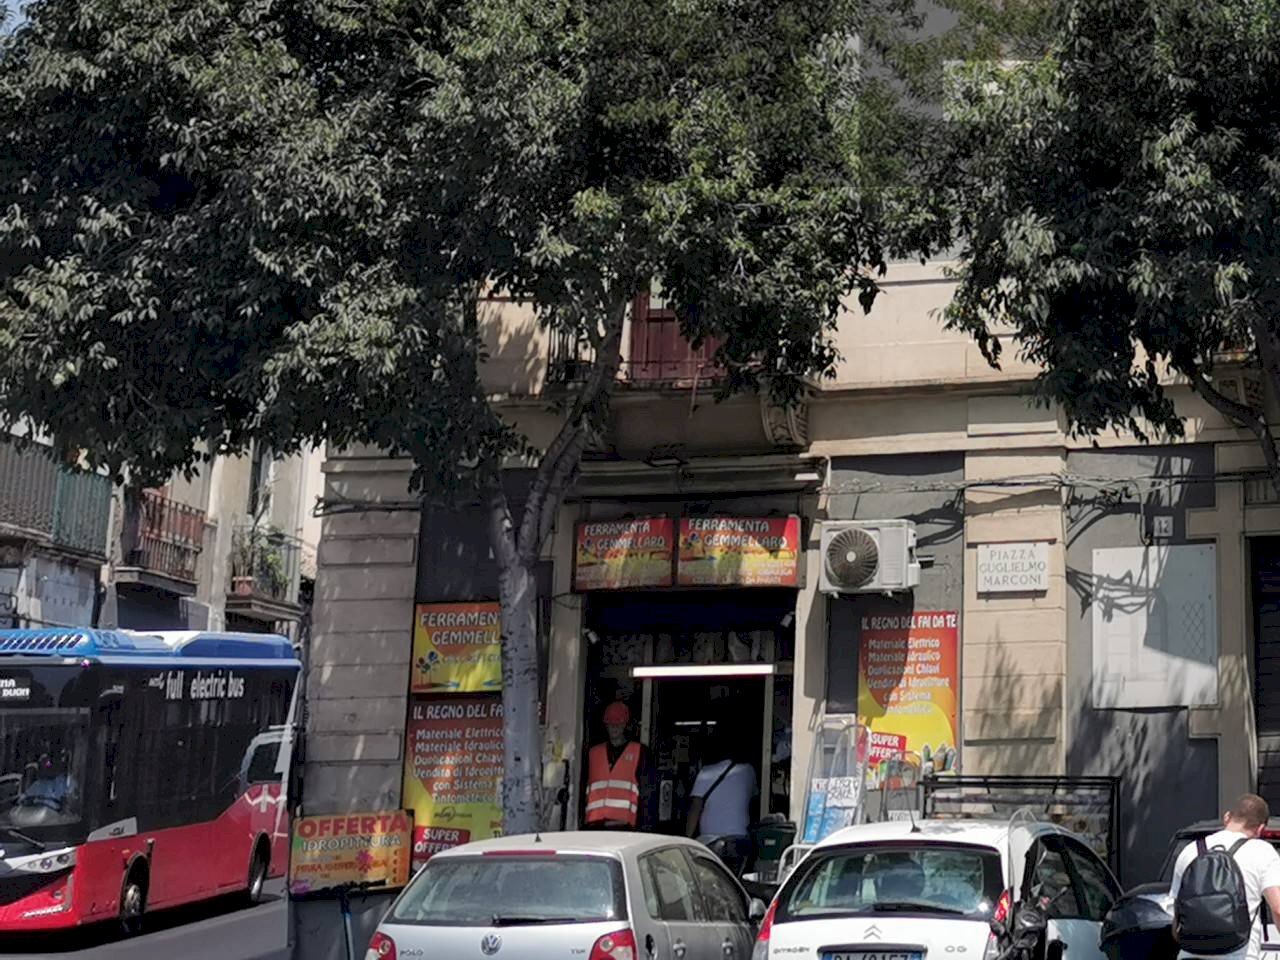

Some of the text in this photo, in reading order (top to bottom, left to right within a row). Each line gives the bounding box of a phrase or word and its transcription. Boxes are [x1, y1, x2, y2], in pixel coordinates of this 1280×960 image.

[584, 522, 650, 537] FERRAMENTA
[688, 518, 770, 532] FERRAMENTA
[1158, 520, 1169, 533] 12
[597, 536, 666, 550] GEMMELLARO
[704, 534, 788, 549] GEMMELLARO
[990, 549, 1036, 560] PIAZZA
[979, 561, 1047, 573] GUGLIELMO
[984, 575, 1041, 585] MARCONI
[421, 612, 501, 627] FERRAMEN
[862, 614, 957, 629] IL REGNO DEL FAI DA TE
[431, 631, 501, 645] GEMMELL
[868, 638, 940, 649] Materiale Elettrico
[868, 651, 941, 662] Materiale Idraulico
[915, 664, 940, 674] Chiavi
[166, 670, 184, 700] full
[190, 670, 226, 699] electric
[227, 670, 245, 698] bus
[413, 703, 504, 720] IL REGNO DEL FA
[416, 729, 462, 740] Materiale
[872, 733, 899, 746] SUPER
[415, 742, 461, 752] Materiale
[414, 753, 505, 767] Duplicazioni Chiav
[413, 767, 451, 779] Vendita
[453, 767, 463, 777] di
[433, 779, 494, 791] con Sistema
[298, 815, 408, 838] OFFERTA
[422, 829, 460, 841] SUPER
[303, 834, 401, 852] IDROPITTURA
